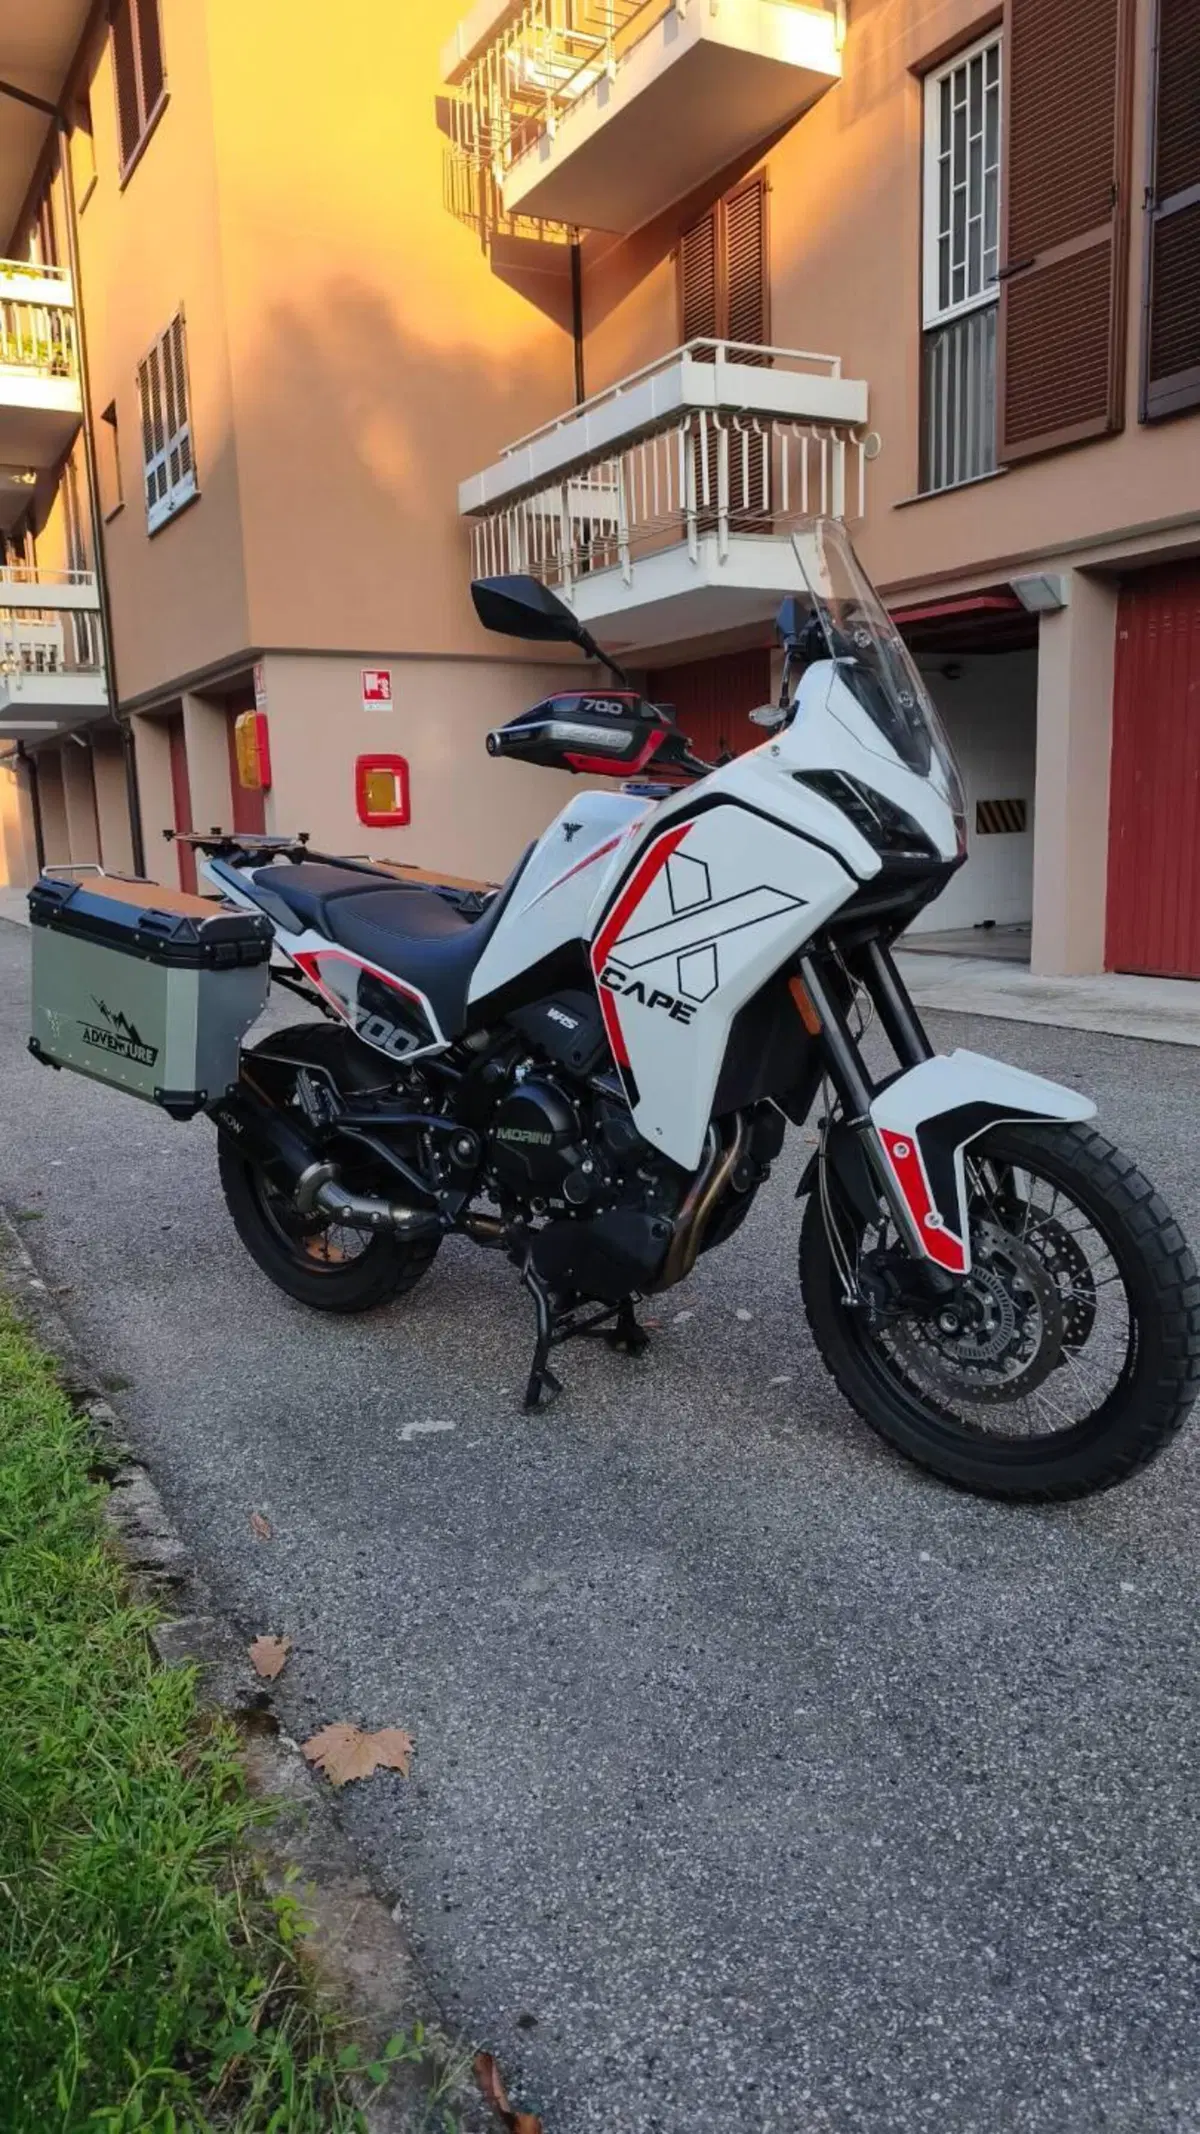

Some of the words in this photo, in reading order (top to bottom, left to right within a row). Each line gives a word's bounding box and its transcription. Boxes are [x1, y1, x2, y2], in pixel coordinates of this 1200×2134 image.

[582, 698, 624, 716] 700
[600, 966, 698, 1026] CAPE
[82, 1027, 155, 1064] ADVENTURE
[496, 1127, 551, 1146] MORINI
